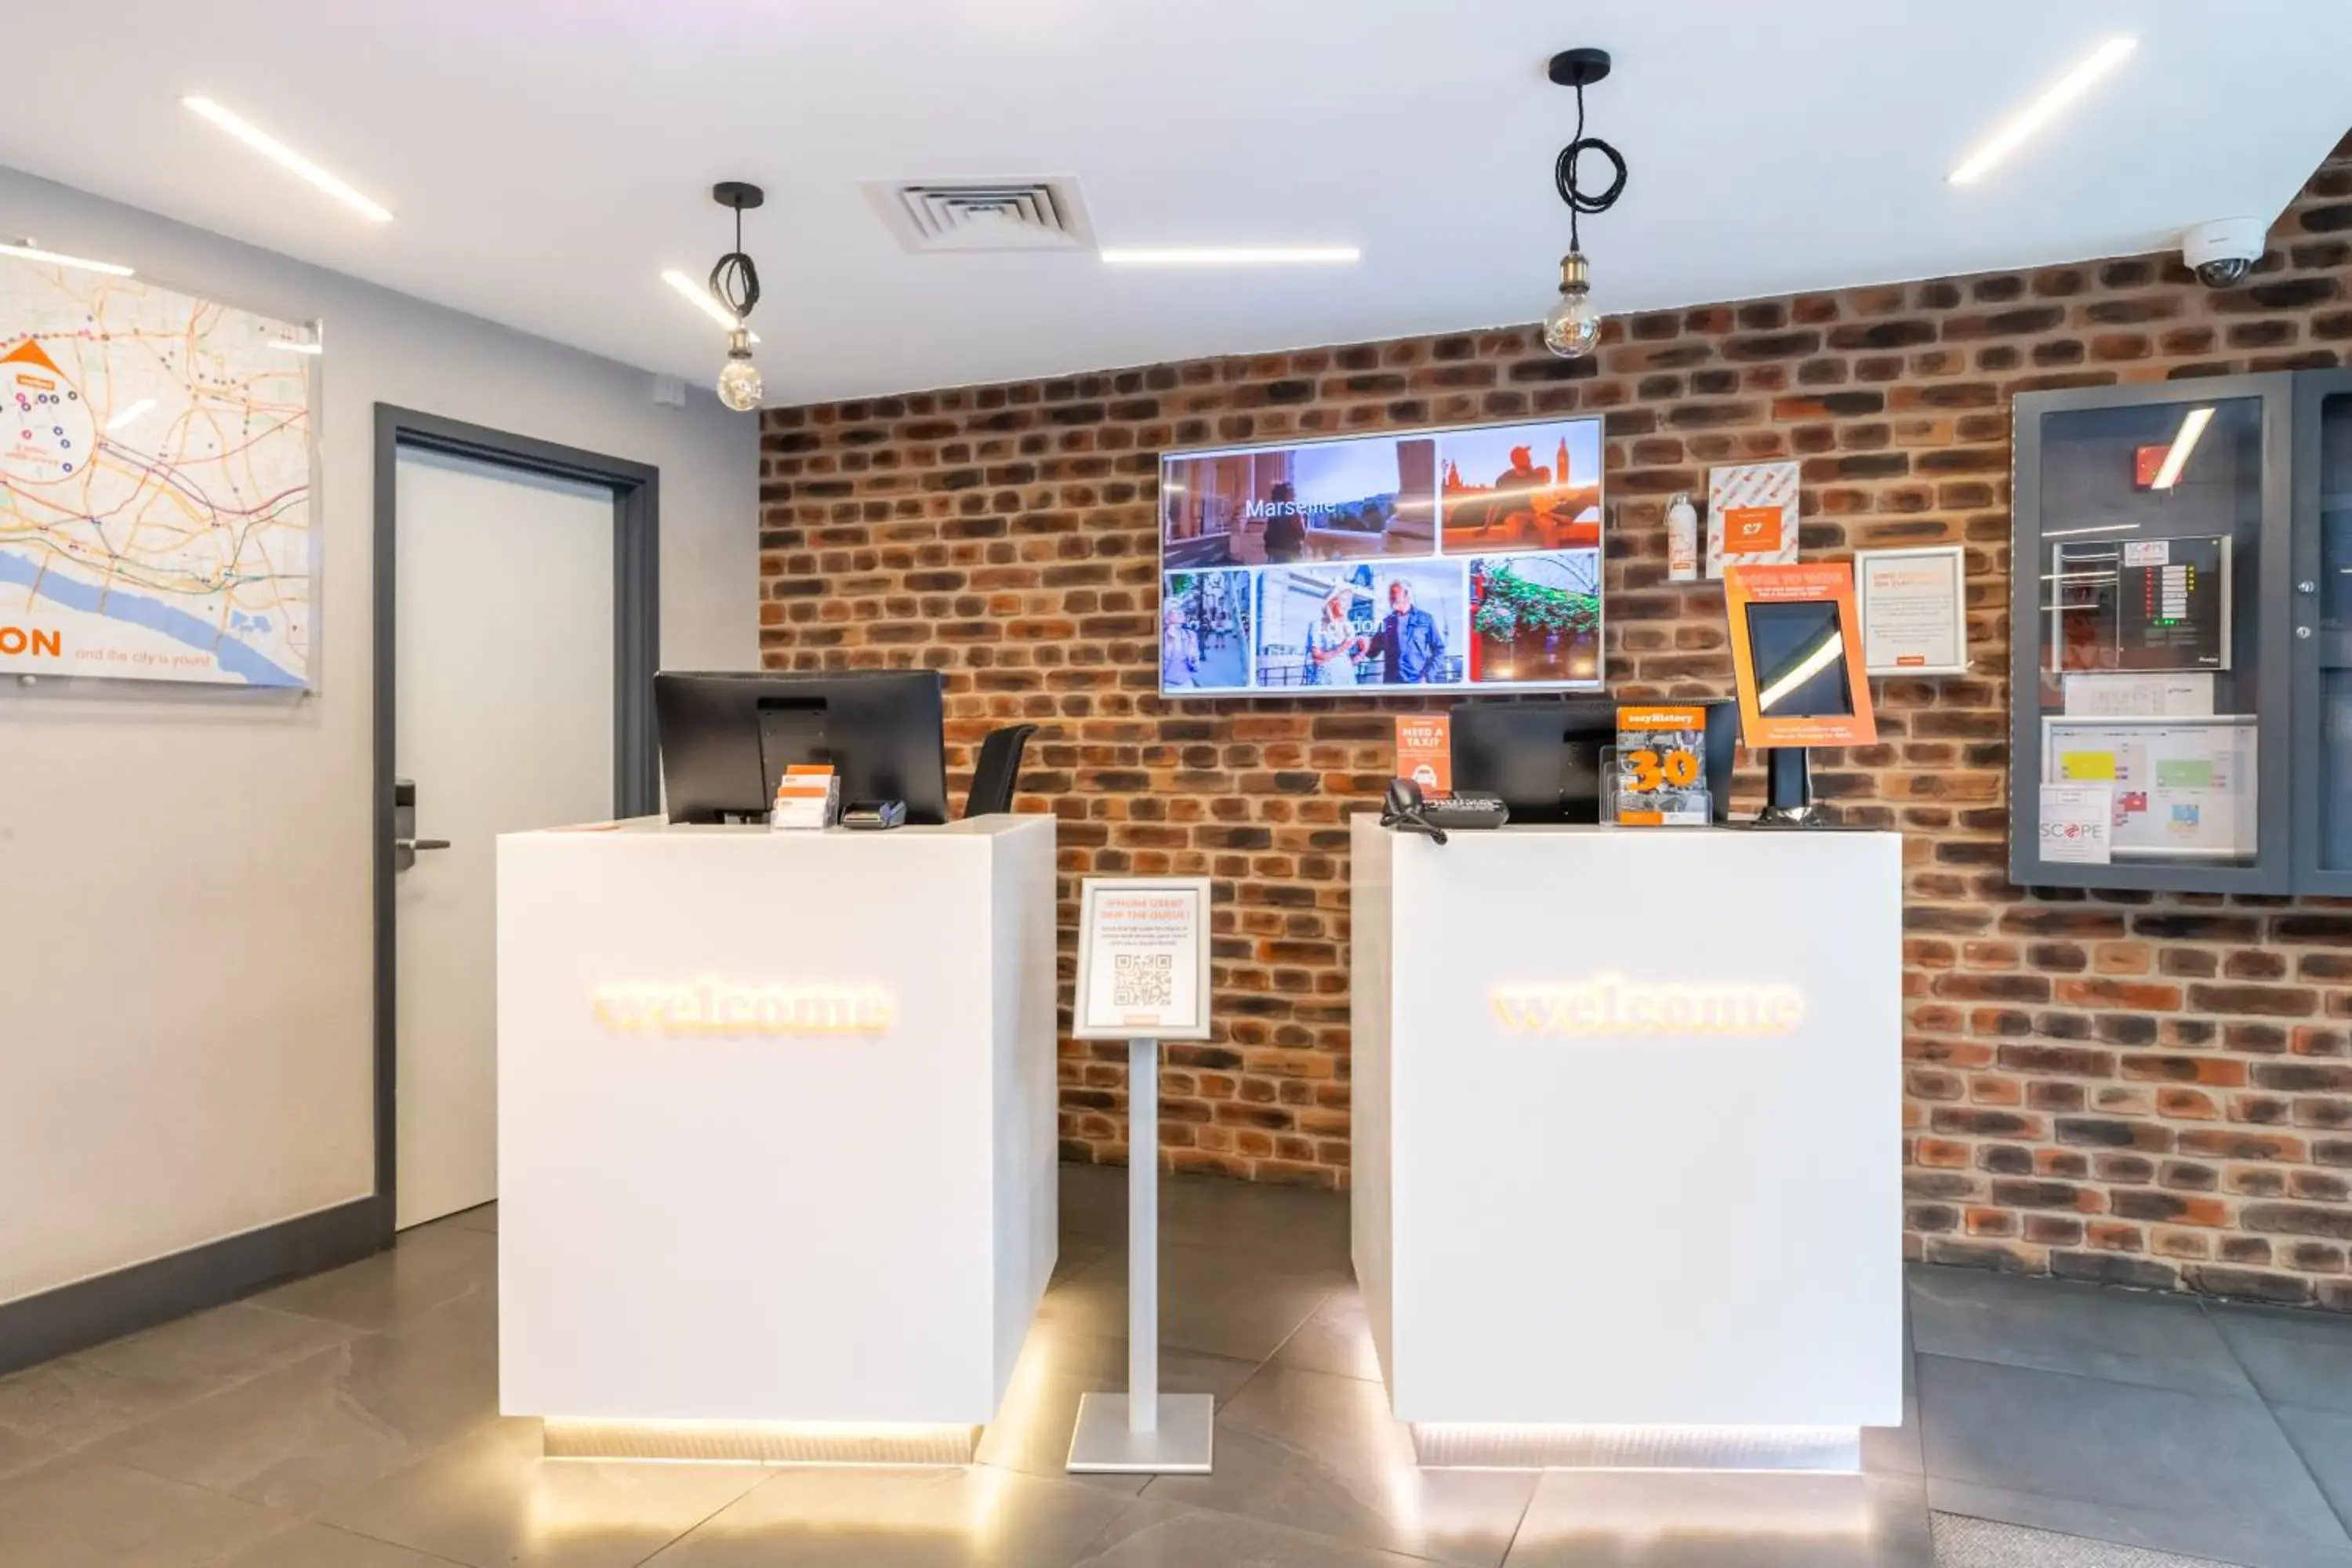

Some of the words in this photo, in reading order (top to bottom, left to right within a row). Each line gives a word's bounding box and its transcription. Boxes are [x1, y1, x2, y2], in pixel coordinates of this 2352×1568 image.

[0, 627, 60, 657] ON
[75, 649, 103, 660] and
[107, 649, 127, 661] the
[132, 652, 154, 666] city
[1403, 727, 1432, 737] NEED
[1436, 727, 1443, 736] A
[1627, 750, 1699, 791] 30
[593, 978, 895, 1038] welcome
[1493, 978, 1802, 1035] welcome
